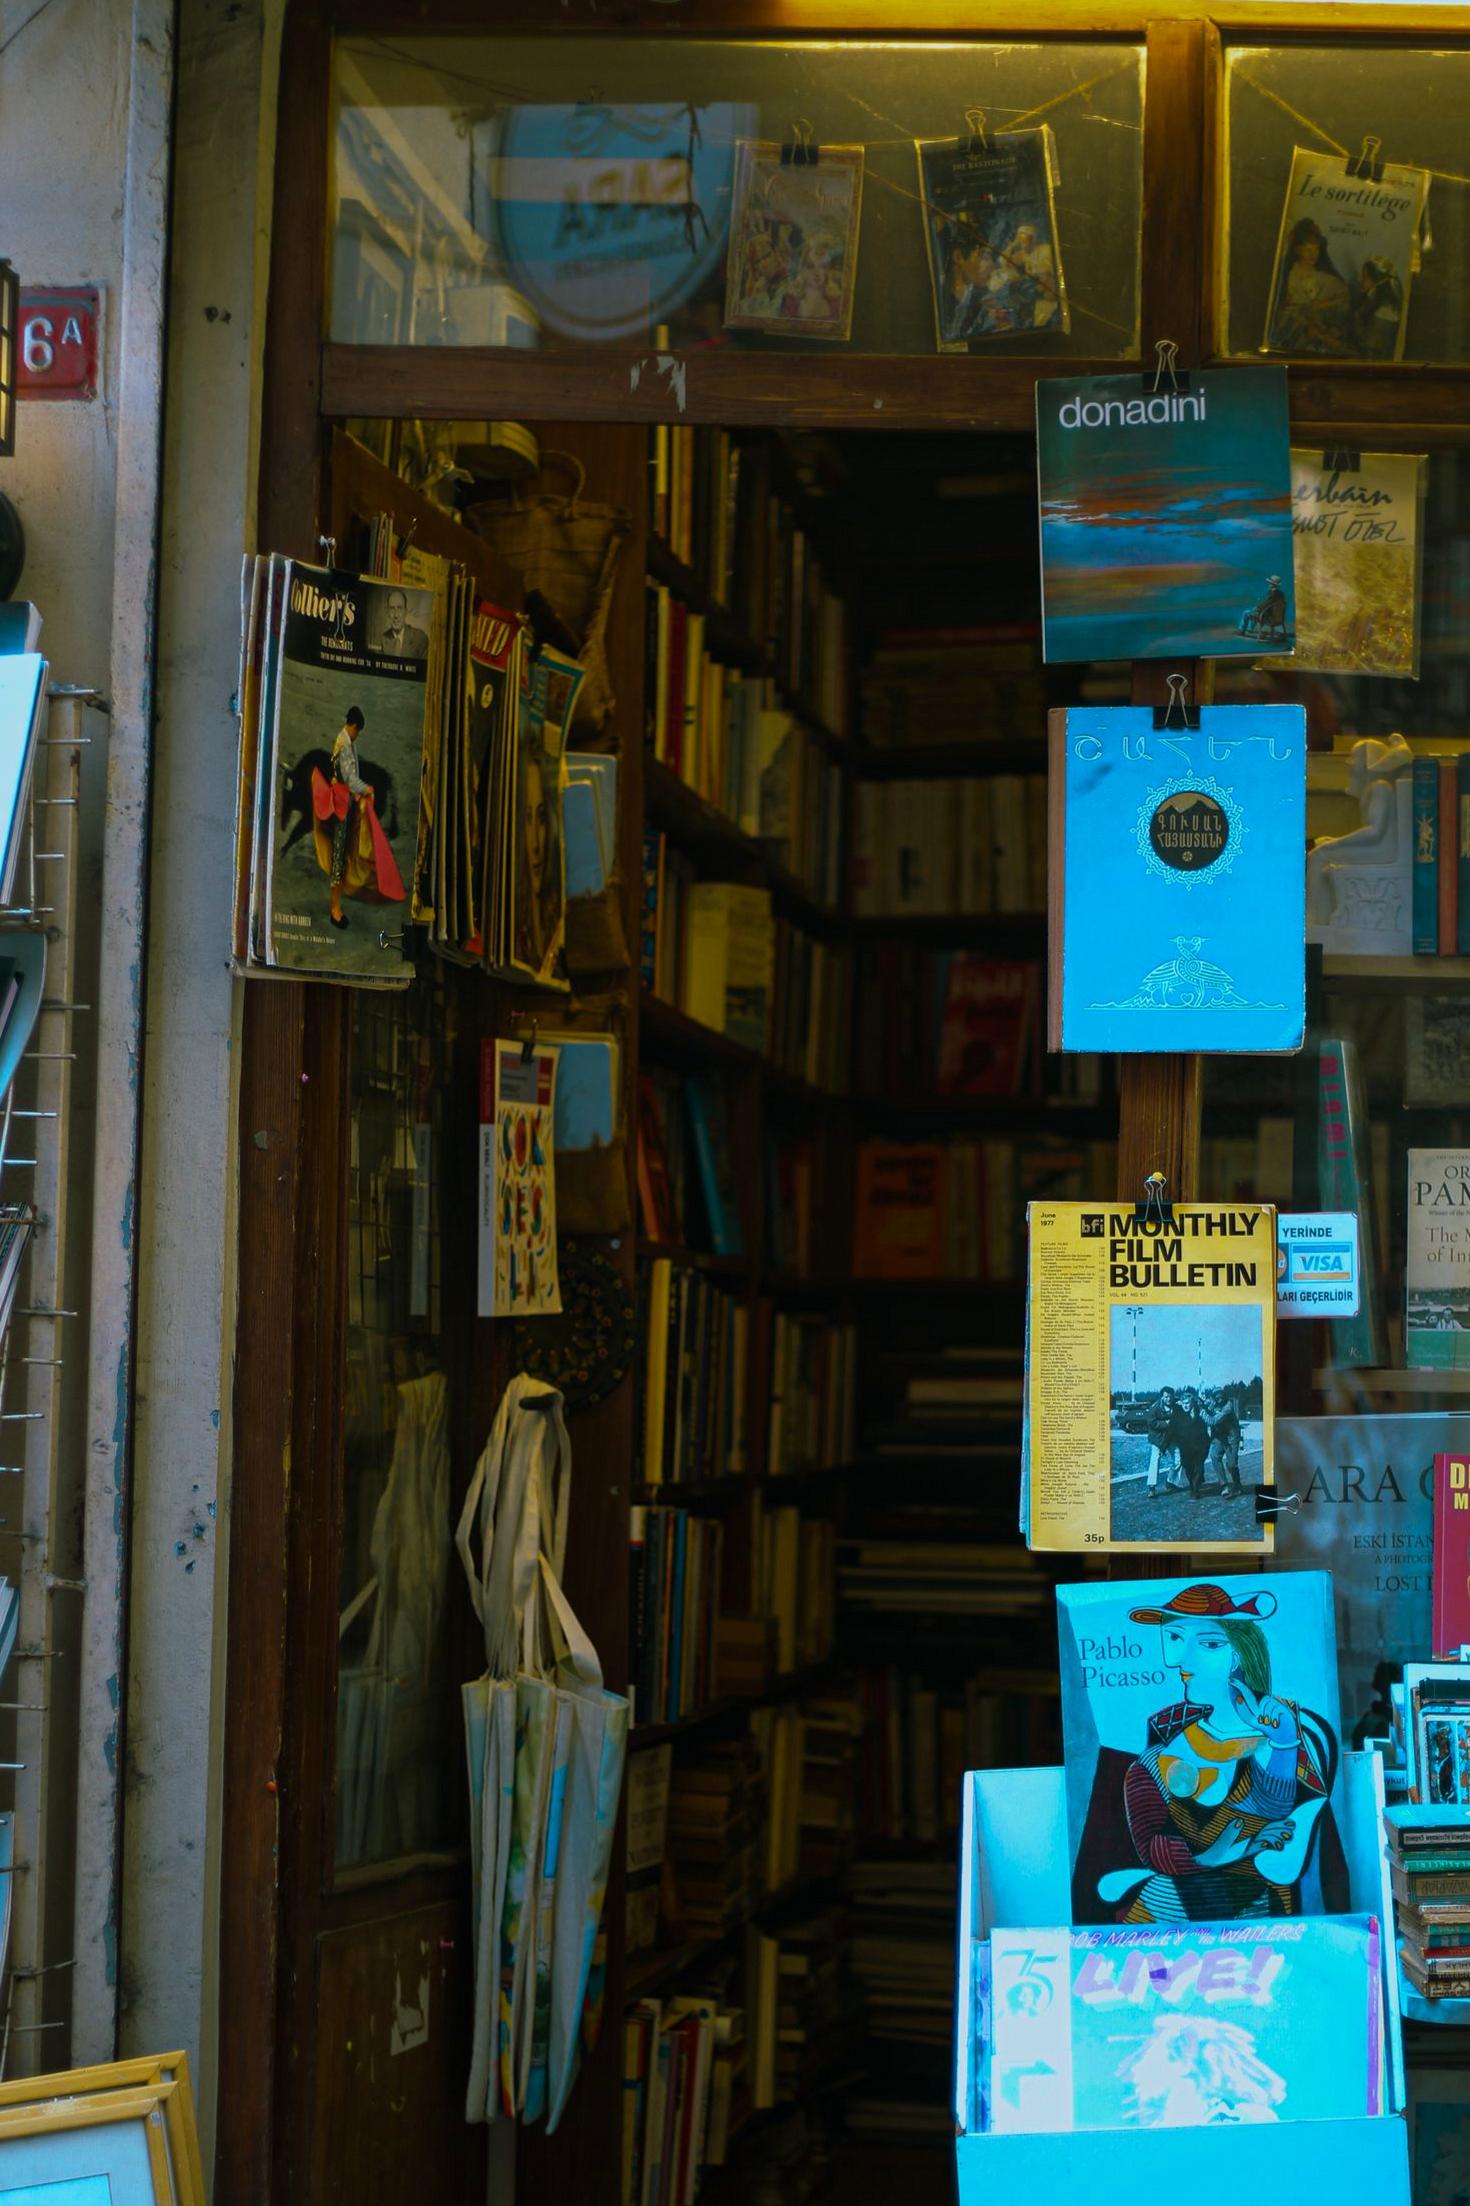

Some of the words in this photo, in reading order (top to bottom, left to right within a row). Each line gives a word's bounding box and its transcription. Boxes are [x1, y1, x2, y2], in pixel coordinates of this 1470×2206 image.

[1297, 173, 1323, 199] Le
[24, 315, 82, 372] 6A
[1058, 388, 1206, 428] donadini
[290, 577, 357, 627] Collier's
[1082, 1219, 1104, 1233] bfi
[1109, 1213, 1260, 1237] MONTHLY
[1282, 1225, 1332, 1238] YERİNDE
[1425, 1226, 1457, 1243] The
[1109, 1239, 1182, 1263] FILM
[1427, 1246, 1446, 1263] of
[1450, 1248, 1470, 1263] In
[1301, 1256, 1344, 1271] VISA
[1109, 1263, 1257, 1288] BULLETIN
[1300, 1289, 1353, 1304] GEÇERLİDİR
[1303, 1464, 1406, 1503] ARA
[1450, 1462, 1470, 1489] D
[1083, 1533, 1105, 1544] 35p
[1353, 1532, 1387, 1549] ESKİ
[1375, 1576, 1421, 1592] LOST
[1079, 1636, 1142, 1661] Pablo
[1081, 1666, 1166, 1688] Picasso
[1104, 1929, 1188, 1947] MARLEY
[1219, 1924, 1306, 1944] WAILERS
[1075, 1945, 1285, 2007] LIVE!
